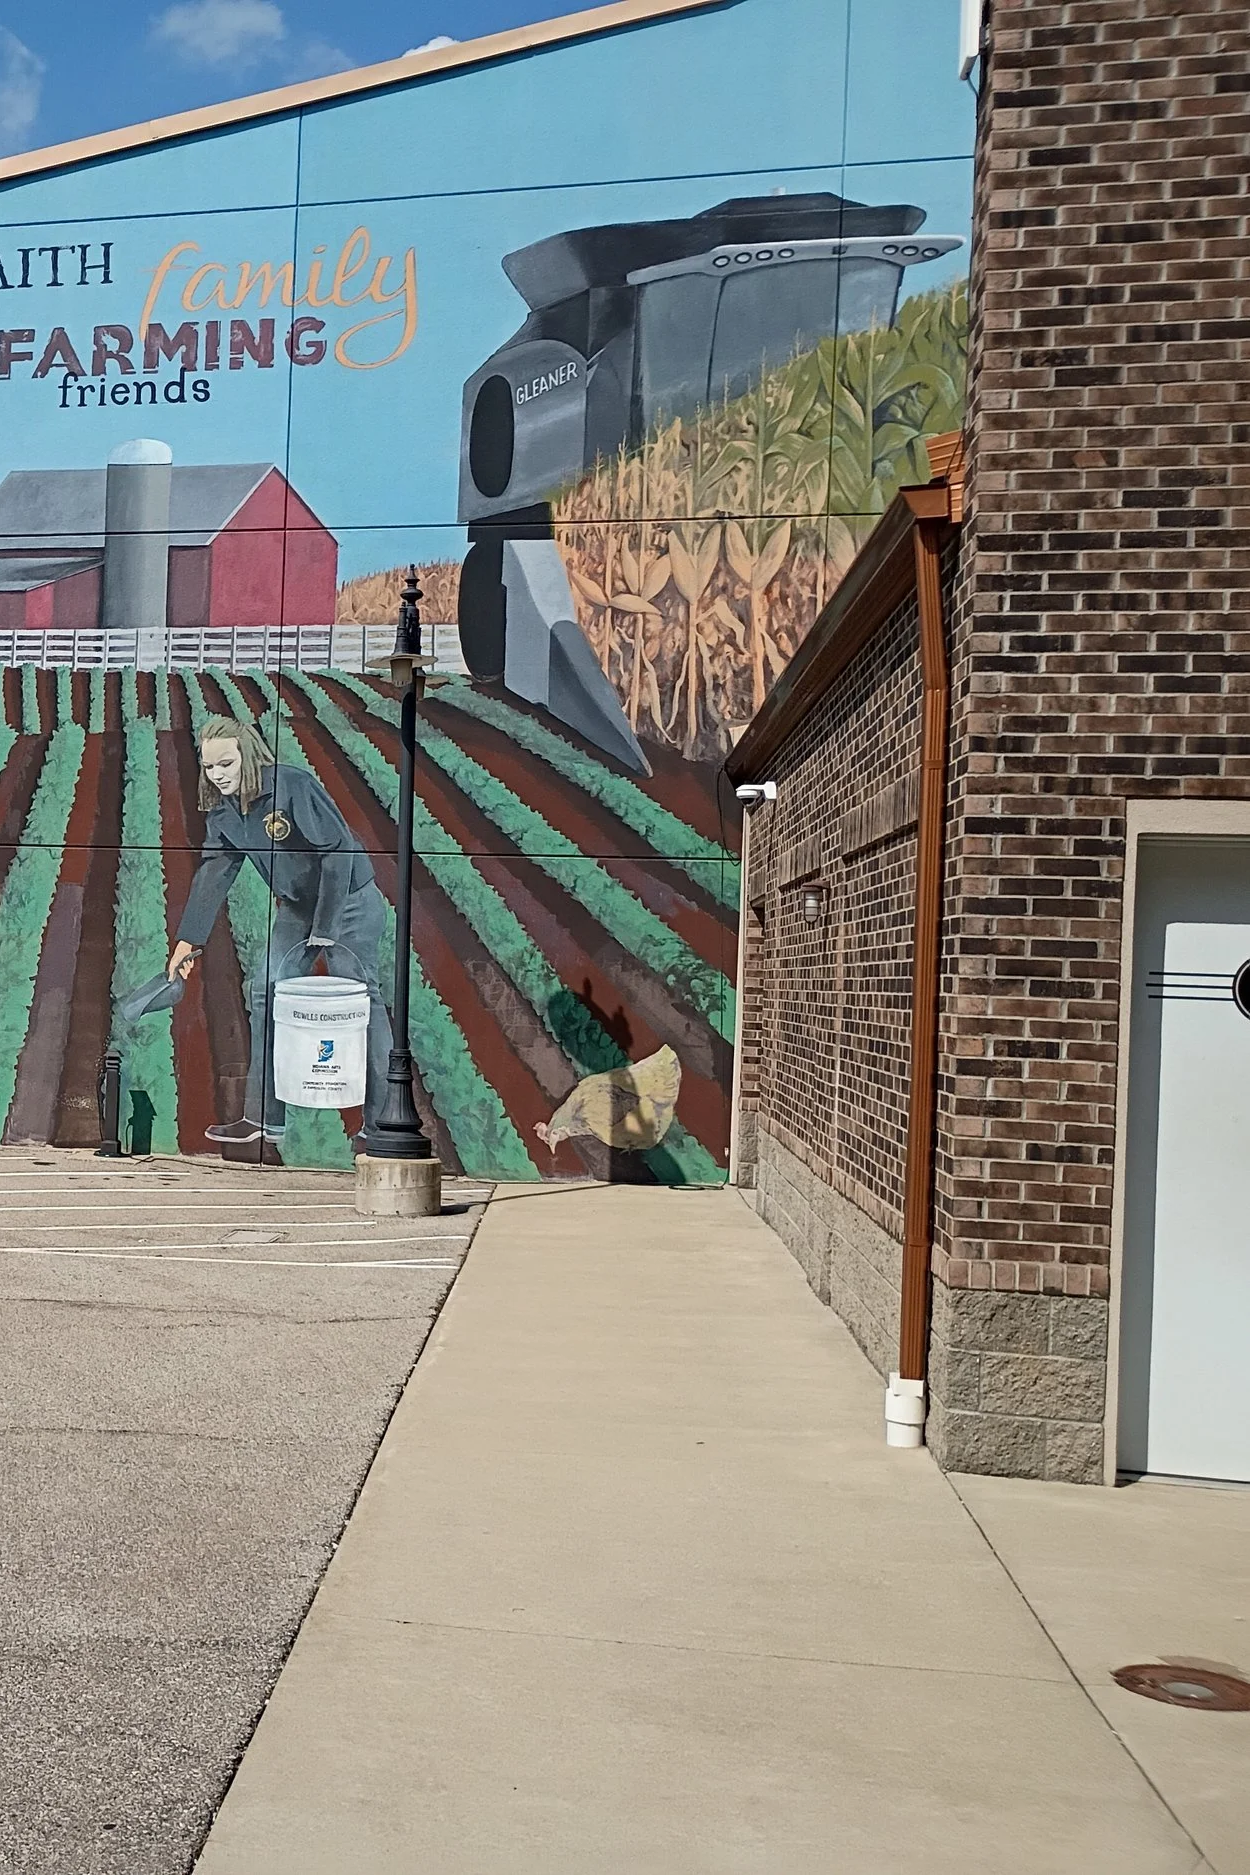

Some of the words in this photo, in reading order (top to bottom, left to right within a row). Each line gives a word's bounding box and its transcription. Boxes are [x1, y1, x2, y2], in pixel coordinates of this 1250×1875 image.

[139, 225, 417, 370] family
[58, 367, 211, 408] friends
[516, 362, 578, 405] GLEANER
